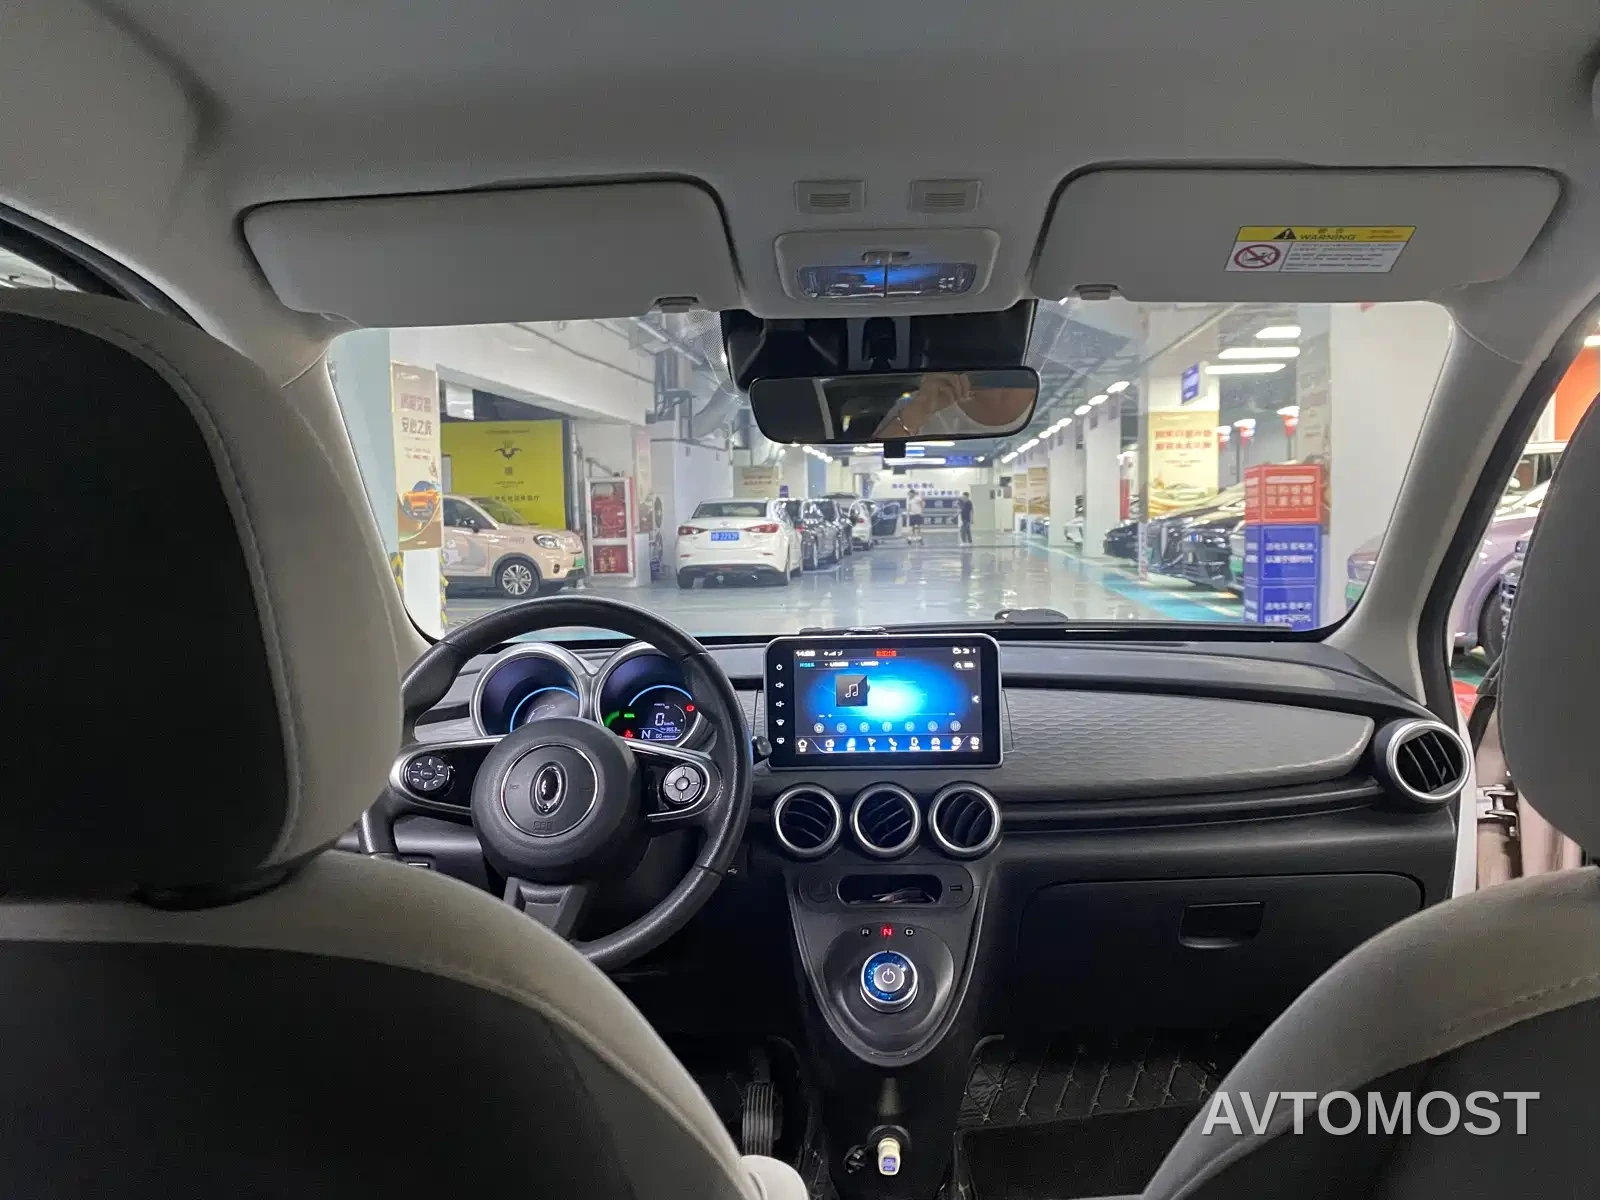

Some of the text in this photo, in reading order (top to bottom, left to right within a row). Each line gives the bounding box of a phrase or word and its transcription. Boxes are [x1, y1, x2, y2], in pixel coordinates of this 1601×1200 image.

[655, 713, 665, 726] 0
[641, 730, 651, 739] N
[883, 928, 892, 936] N
